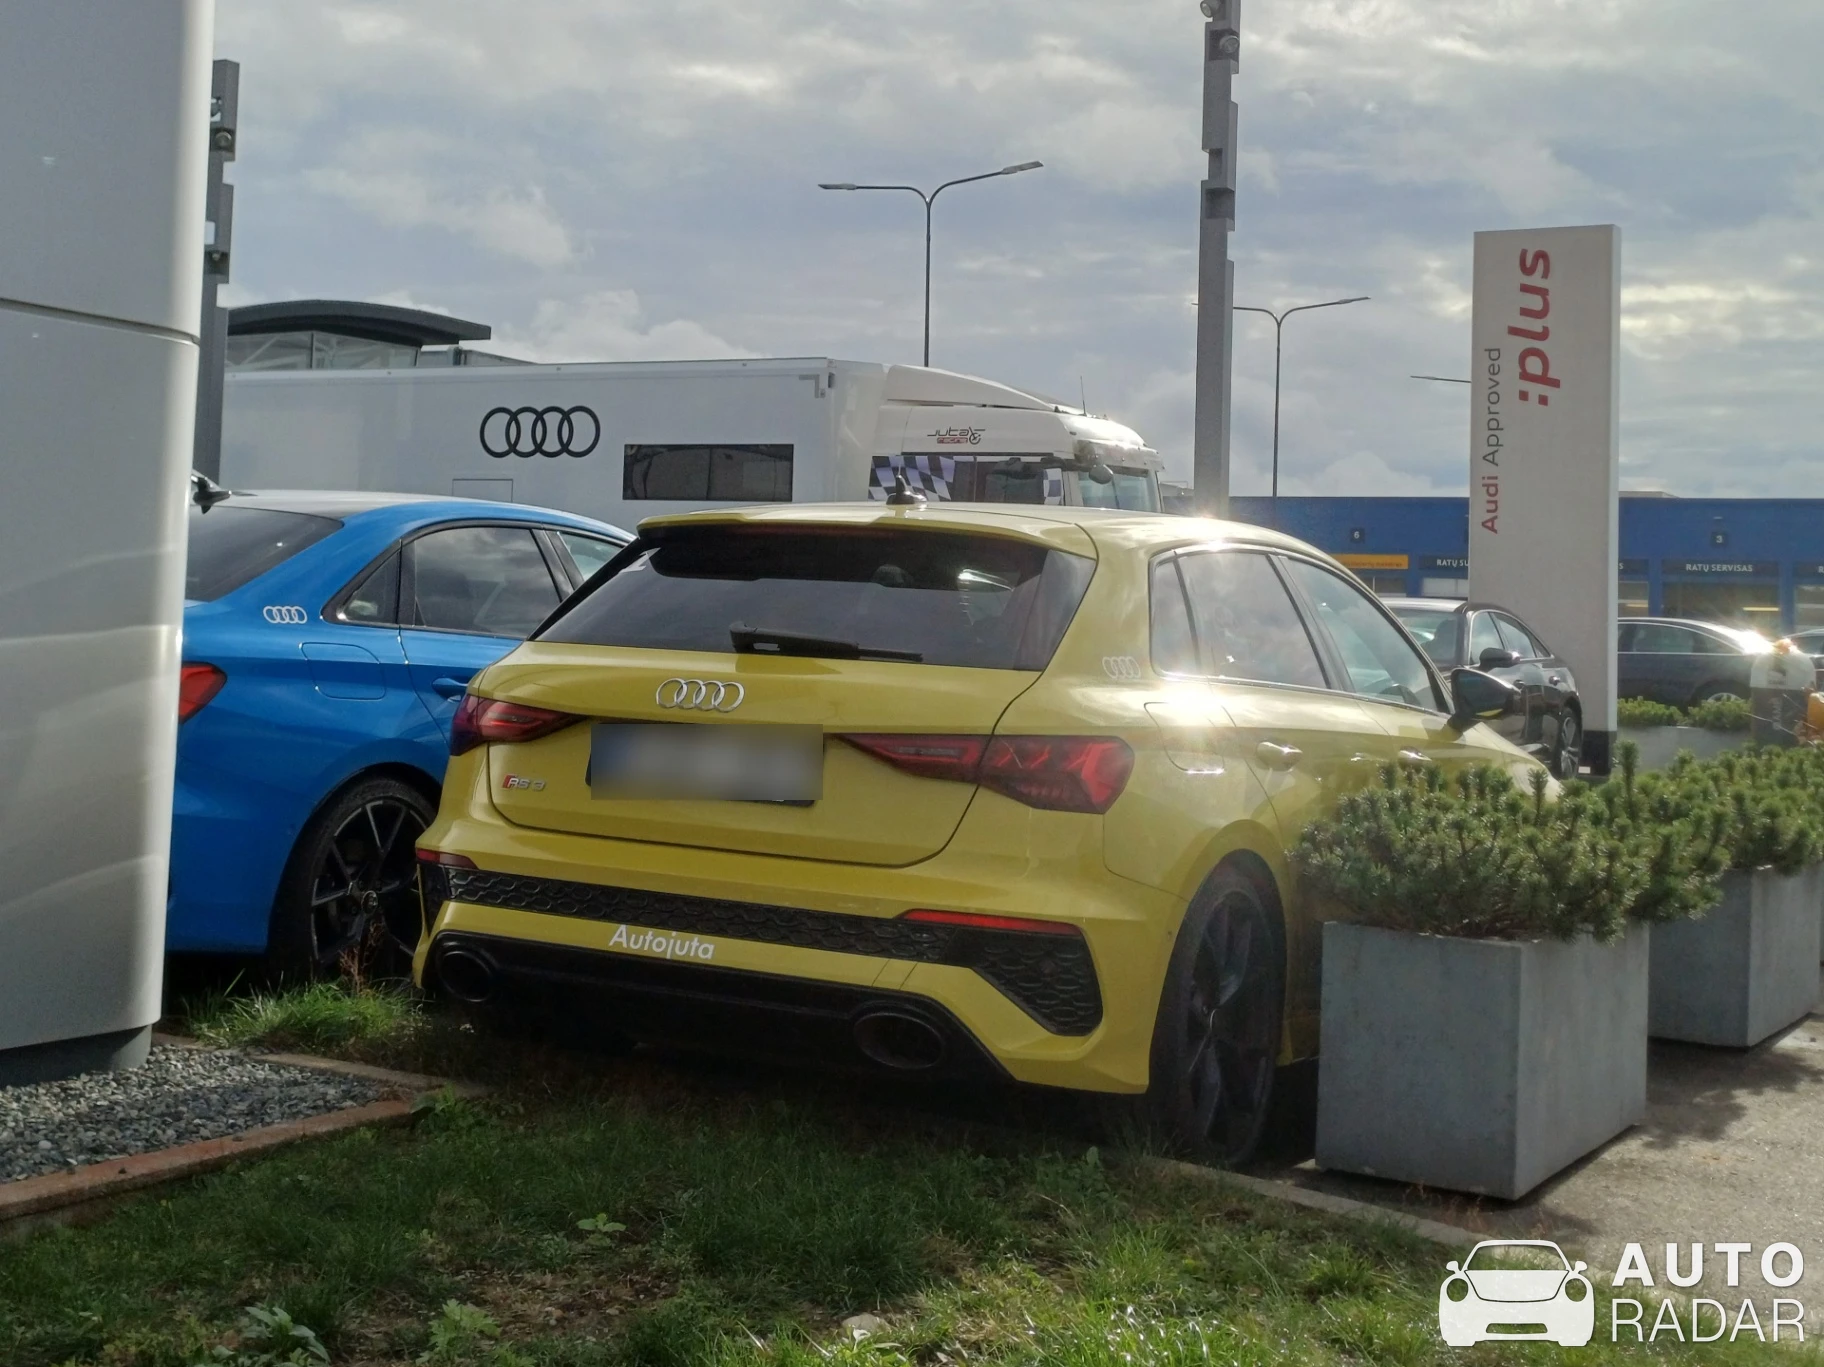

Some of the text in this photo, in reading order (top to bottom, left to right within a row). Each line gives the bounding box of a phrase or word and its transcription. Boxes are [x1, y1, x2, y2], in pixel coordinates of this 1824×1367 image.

[1481, 347, 1504, 534] Audi Approved
[1353, 531, 1360, 539] 6
[1716, 535, 1723, 543] 3
[1685, 563, 1753, 572] RATŲ SERVISAS
[608, 924, 715, 960] Autojuta
